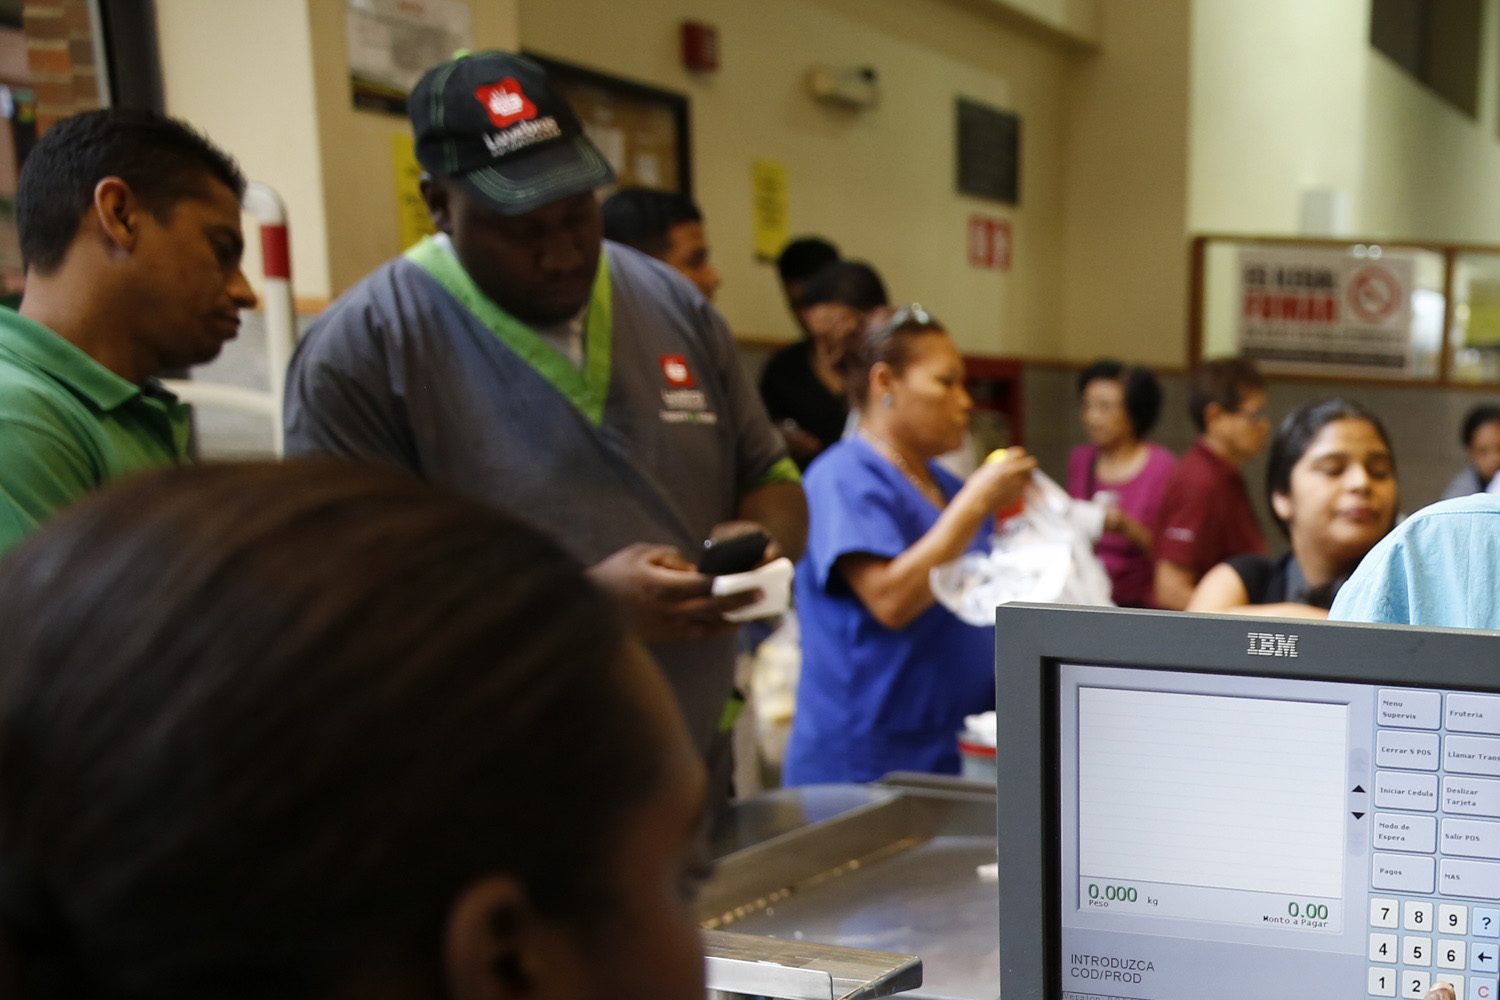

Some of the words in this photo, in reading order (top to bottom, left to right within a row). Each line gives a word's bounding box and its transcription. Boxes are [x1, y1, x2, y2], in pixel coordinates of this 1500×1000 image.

[1247, 632, 1299, 658] IBM
[1087, 884, 1138, 903] 0.000
[1146, 896, 1159, 906] kg
[1088, 899, 1109, 908] Peso
[1287, 901, 1329, 920] 0.00
[1381, 907, 1390, 921] 7
[1414, 910, 1424, 924] 8
[1448, 913, 1458, 927] 9
[1263, 915, 1291, 925] Monto
[1301, 919, 1329, 928] Pagar
[1481, 916, 1491, 930] ?
[1378, 942, 1388, 956] 4
[1413, 946, 1422, 959] 5
[1446, 949, 1456, 963] 6
[1070, 953, 1155, 973] INTRODUZCA
[1070, 967, 1142, 984] COD/PROD
[1378, 976, 1386, 989] 1
[1411, 979, 1421, 993] 2
[1477, 985, 1489, 999] C
